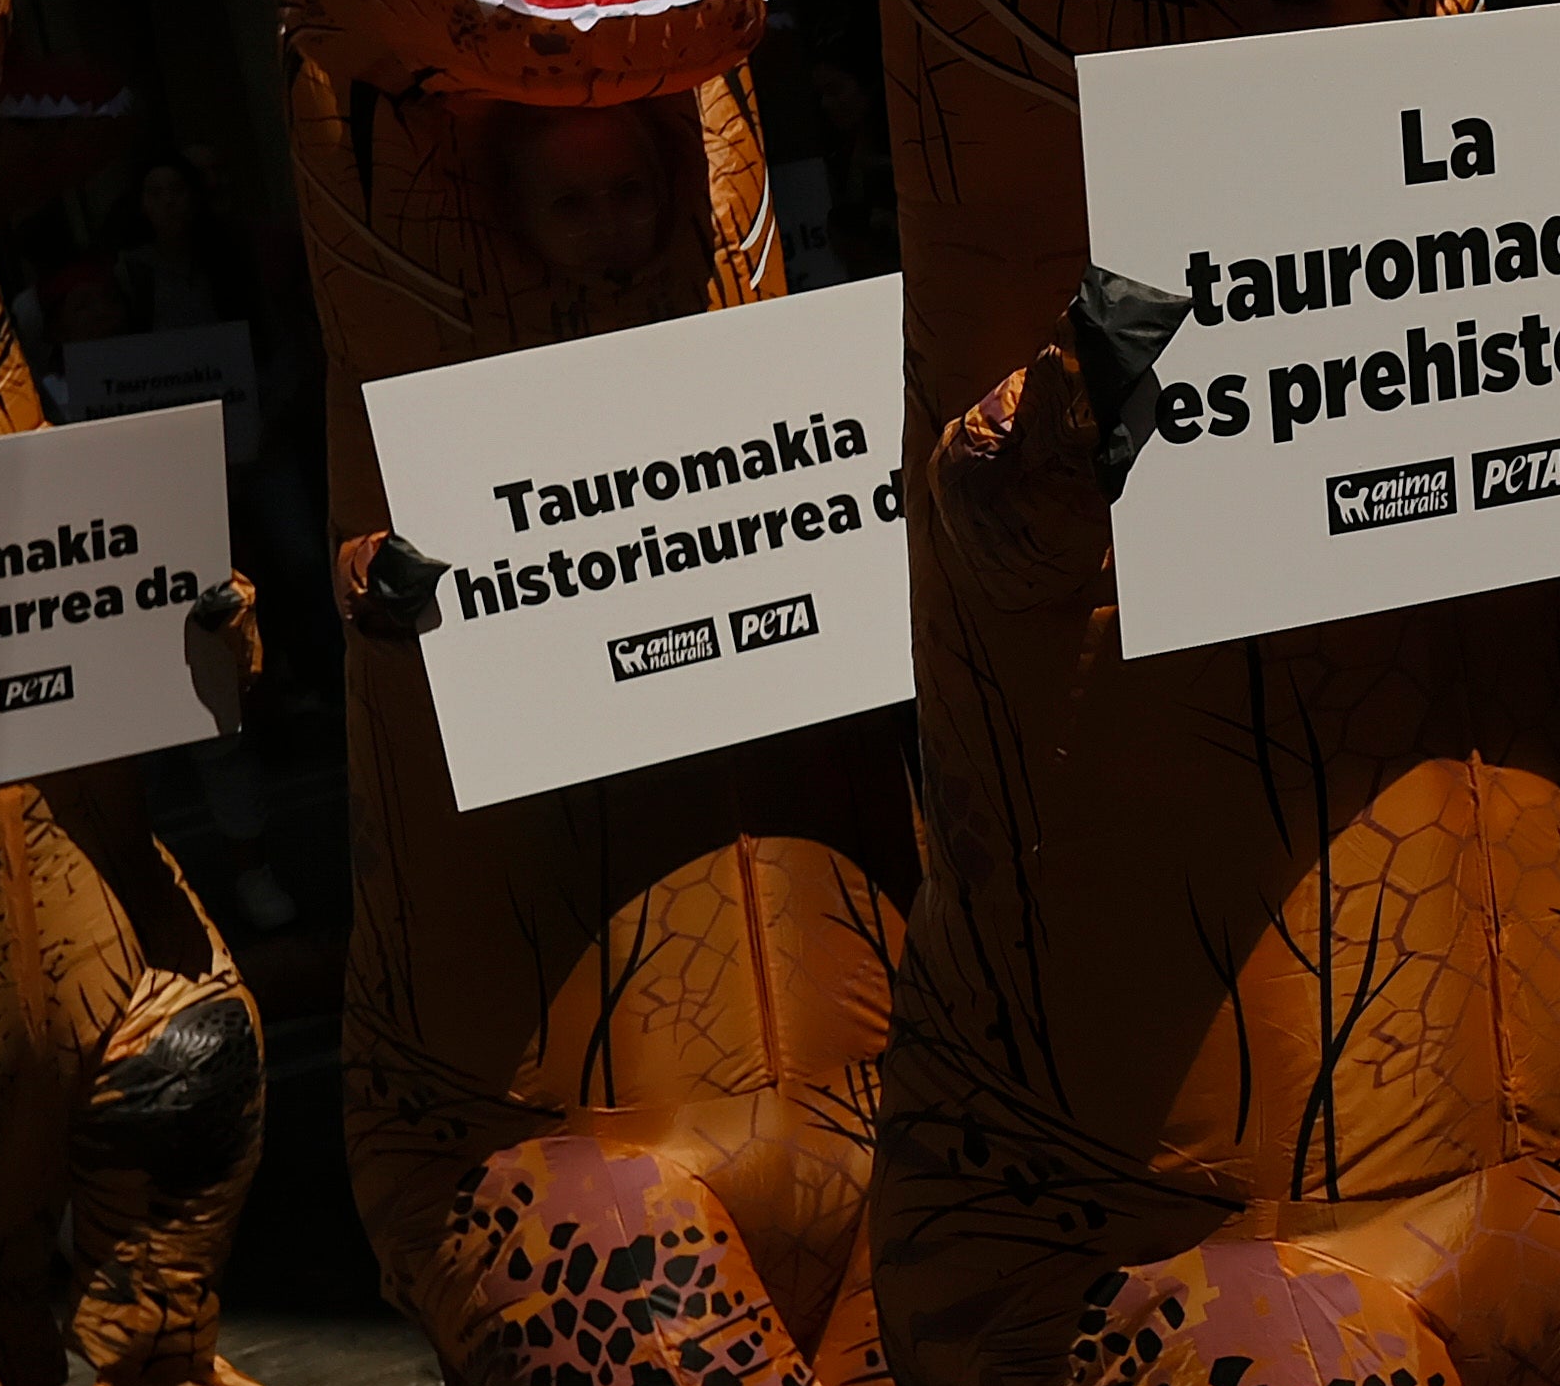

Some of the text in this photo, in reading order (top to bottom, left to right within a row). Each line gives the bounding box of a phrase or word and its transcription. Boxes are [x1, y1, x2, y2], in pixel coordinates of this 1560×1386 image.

[1400, 109, 1496, 185] La
[1154, 372, 1250, 445] es
[495, 413, 868, 532] Tauromakia
[1371, 468, 1448, 501] anima
[1372, 488, 1450, 523] naturalis
[454, 467, 907, 621] historiaurrea d
[136, 566, 199, 610] da
[645, 625, 711, 657] anima
[649, 642, 714, 669] naturalis
